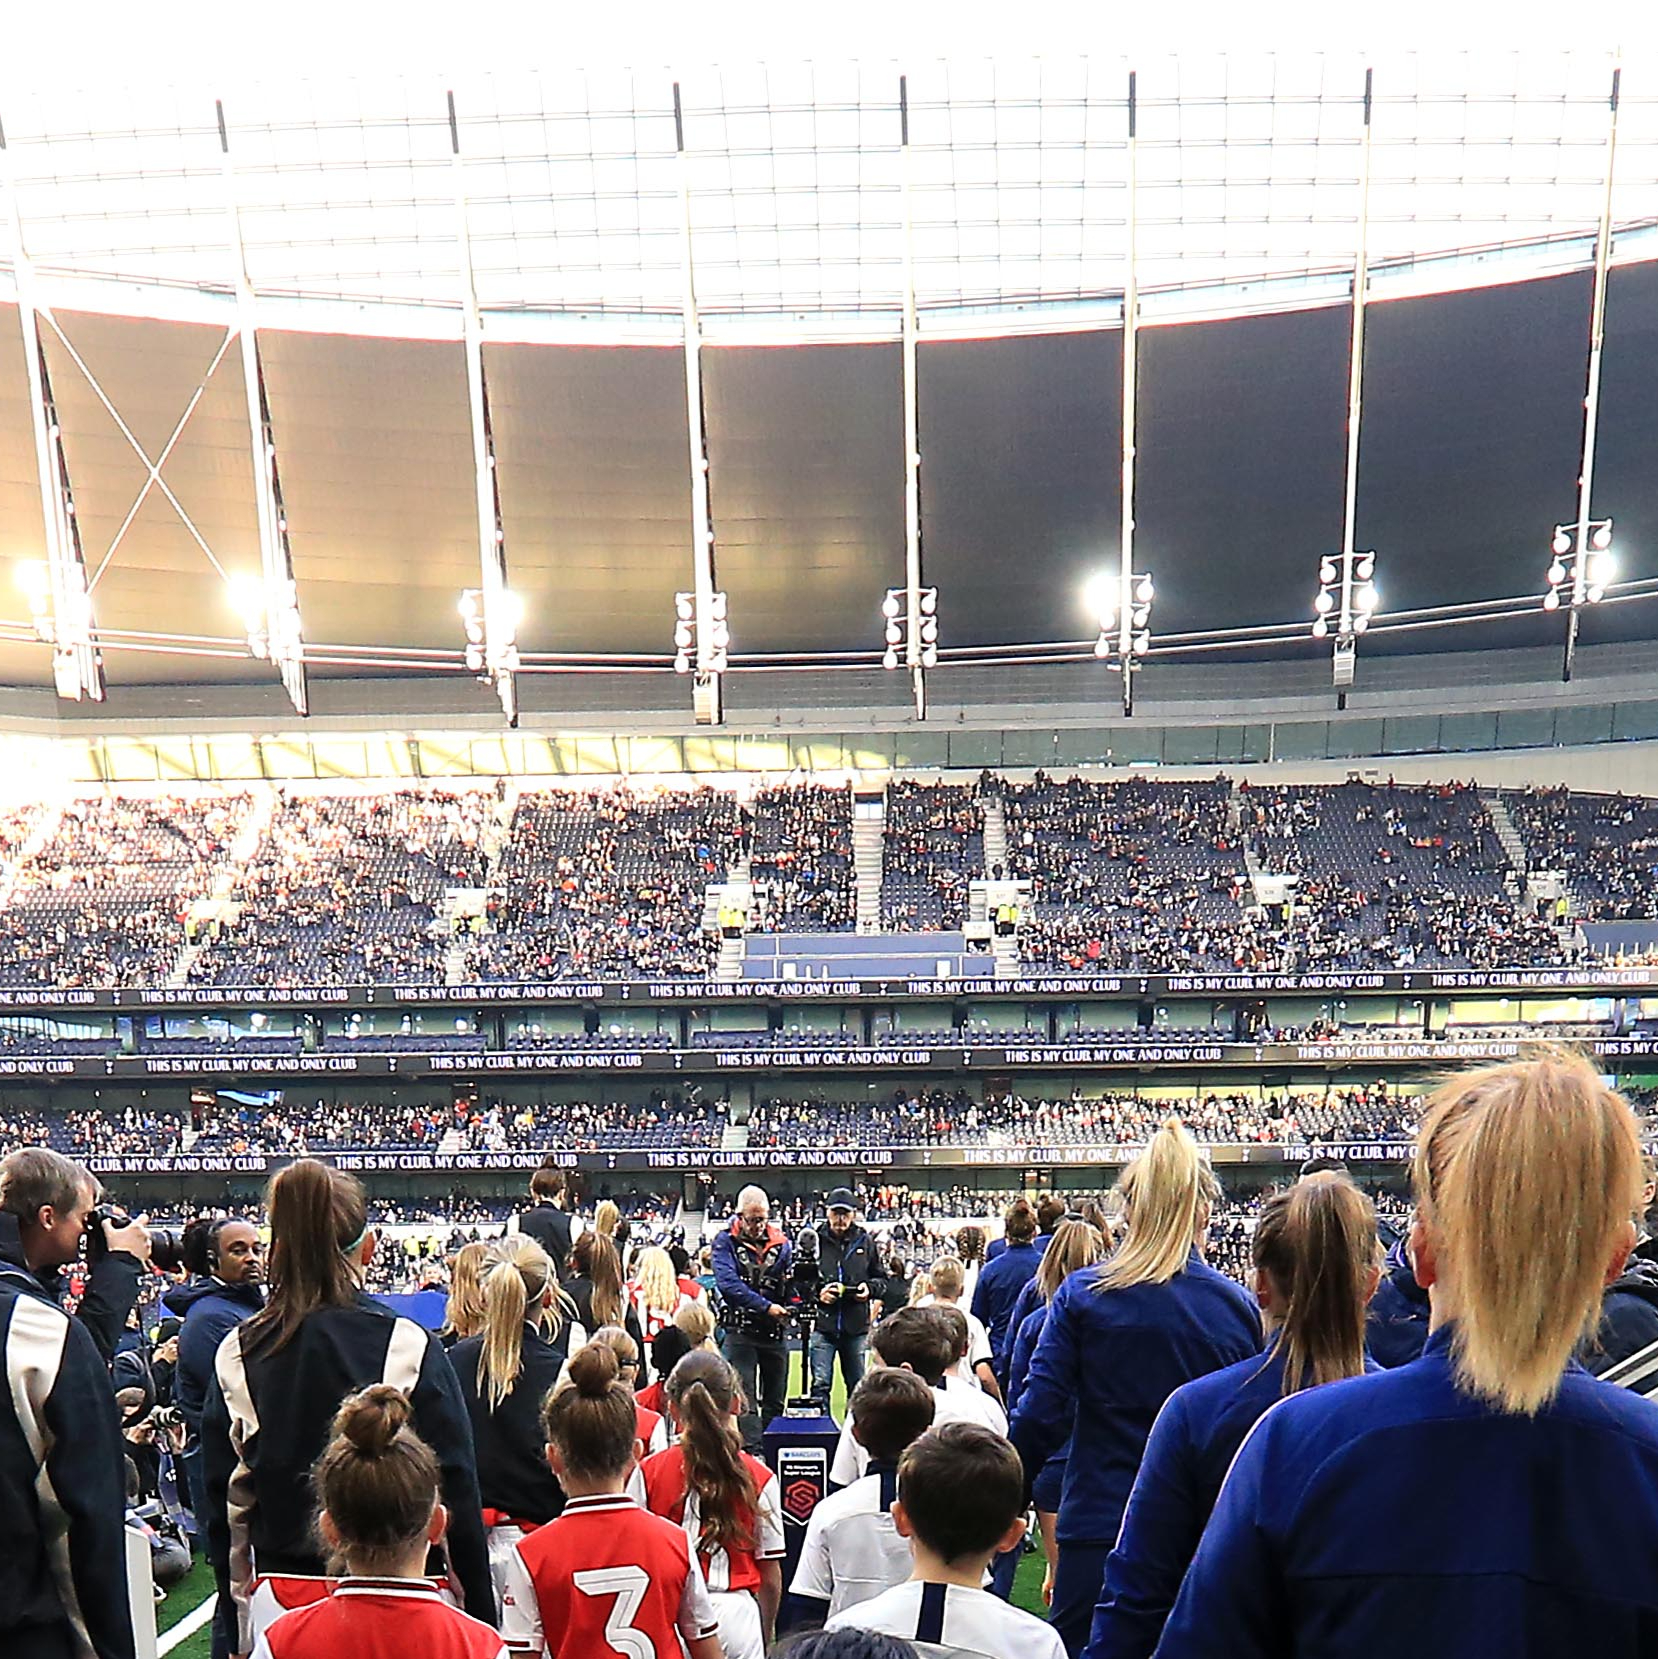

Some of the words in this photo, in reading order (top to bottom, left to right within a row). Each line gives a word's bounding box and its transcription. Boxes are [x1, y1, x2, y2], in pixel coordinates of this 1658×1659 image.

[649, 983, 673, 997] THIS
[674, 983, 685, 997] IS
[686, 983, 702, 997] MY
[735, 983, 751, 996] MY
[754, 983, 777, 996] ONE
[778, 983, 802, 995] AND
[803, 982, 829, 995] ONLY
[832, 982, 860, 995] CLUB
[15, 991, 38, 1004] AND
[39, 991, 65, 1003] ONLY
[67, 991, 94, 1003] CLUB
[1594, 1041, 1618, 1053] THIS
[1620, 1041, 1631, 1053] IS
[1633, 1041, 1651, 1053] MY
[430, 1056, 453, 1069] THIS
[455, 1056, 465, 1069] IS
[467, 1056, 483, 1069] MY
[516, 1055, 532, 1068] MY
[535, 1055, 558, 1068] ONE
[560, 1054, 583, 1067] AND
[585, 1054, 610, 1067] ONLY
[613, 1054, 641, 1067] CLUB
[648, 1151, 674, 1167] THIS
[676, 1151, 688, 1166] IS
[690, 1151, 709, 1166] MY
[747, 1151, 768, 1165] MY
[769, 1151, 794, 1165] ONE
[798, 1151, 825, 1165] AND
[826, 1151, 856, 1164] ONLY
[860, 1151, 892, 1164] CLUB
[964, 1149, 990, 1164] THIS
[992, 1149, 1004, 1164] IS
[1006, 1148, 1026, 1164] MY
[1064, 1148, 1083, 1163] MY
[1086, 1147, 1112, 1163] ONE
[1114, 1147, 1142, 1163] AND
[1283, 1145, 1310, 1160] THIS
[1312, 1145, 1324, 1160] IS
[1326, 1145, 1347, 1159] MY
[1386, 1144, 1406, 1159] MY
[124, 1157, 143, 1171] MY
[146, 1157, 172, 1171] ONE
[174, 1157, 200, 1171] AND
[202, 1157, 231, 1171] ONLY
[234, 1157, 266, 1171] CLUB
[336, 1155, 362, 1169] THIS
[364, 1155, 376, 1169] IS
[378, 1155, 396, 1169] MY
[434, 1154, 453, 1168] MY
[456, 1154, 481, 1168] ONE
[484, 1154, 511, 1168] AND
[512, 1154, 542, 1168] ONLY
